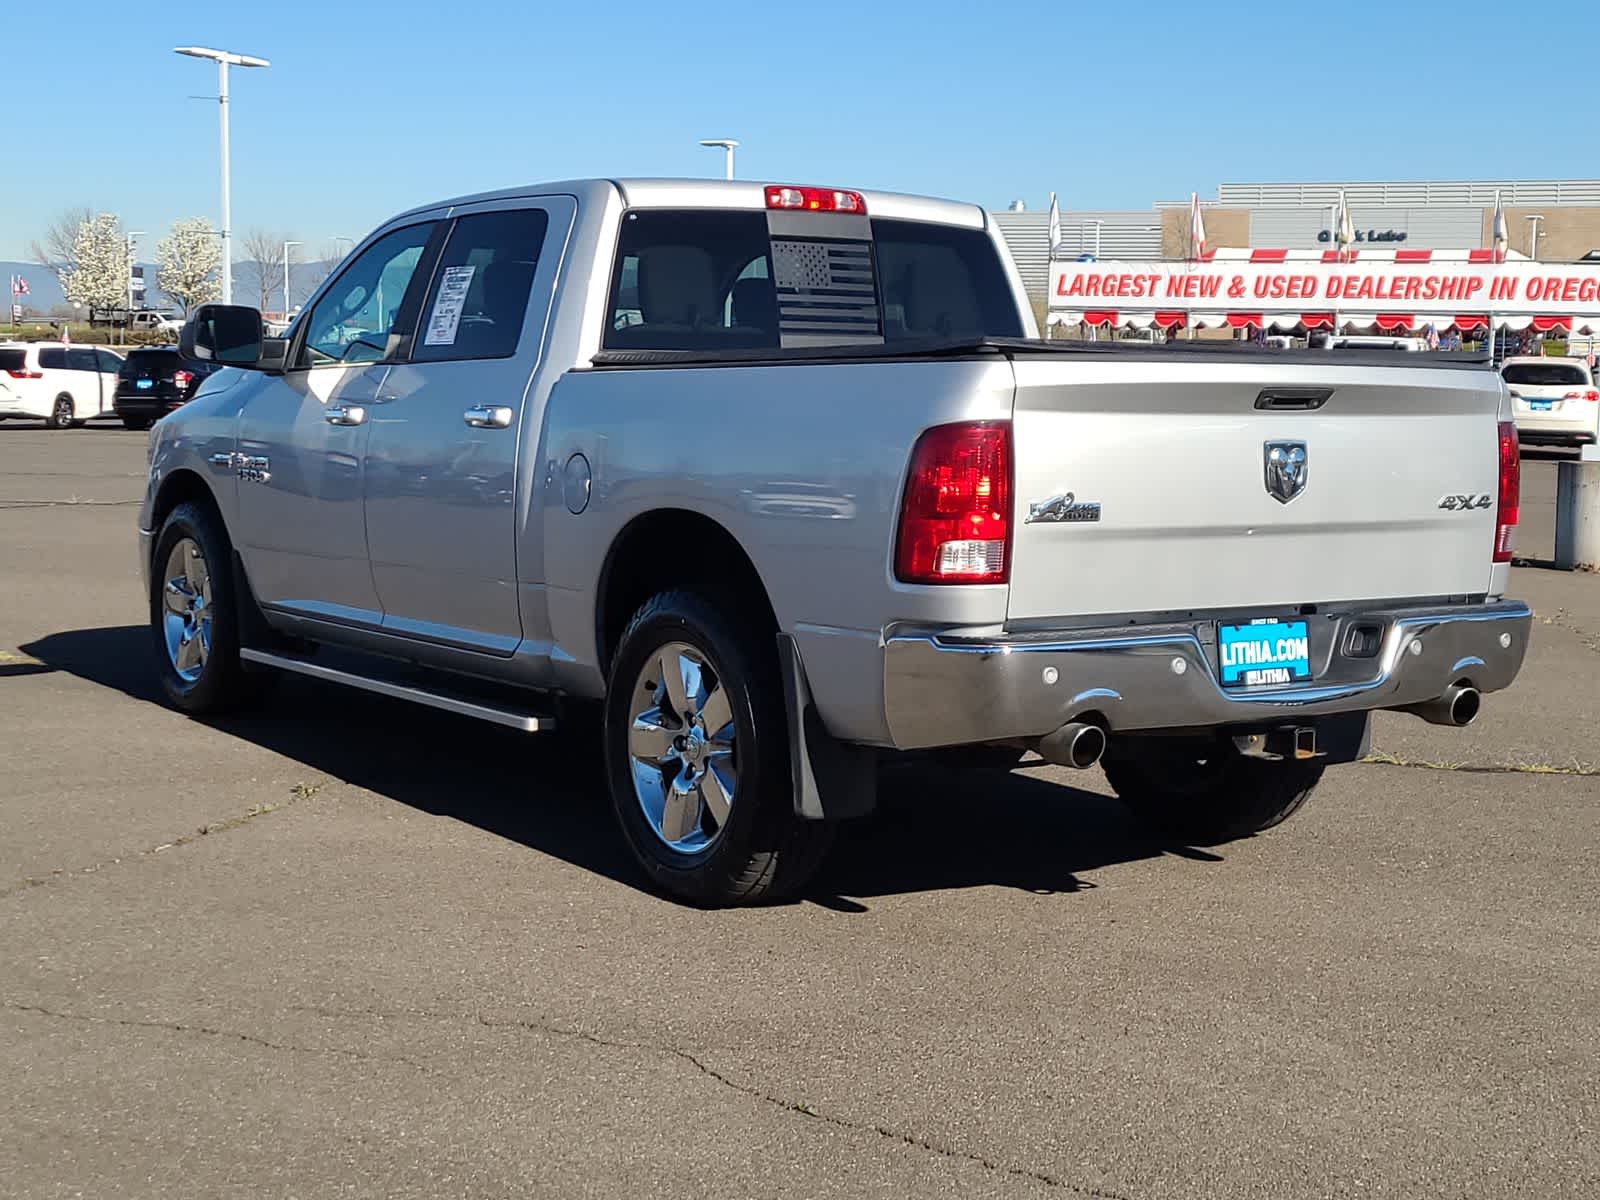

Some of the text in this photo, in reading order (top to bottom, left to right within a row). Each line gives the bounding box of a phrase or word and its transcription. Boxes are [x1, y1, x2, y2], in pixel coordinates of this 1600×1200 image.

[1056, 273, 1600, 302] LARGEST NEW & USED DEALERSHIP IN OREG
[1221, 637, 1309, 666] LITHIA.COM
[1256, 668, 1291, 684] LITHIA
